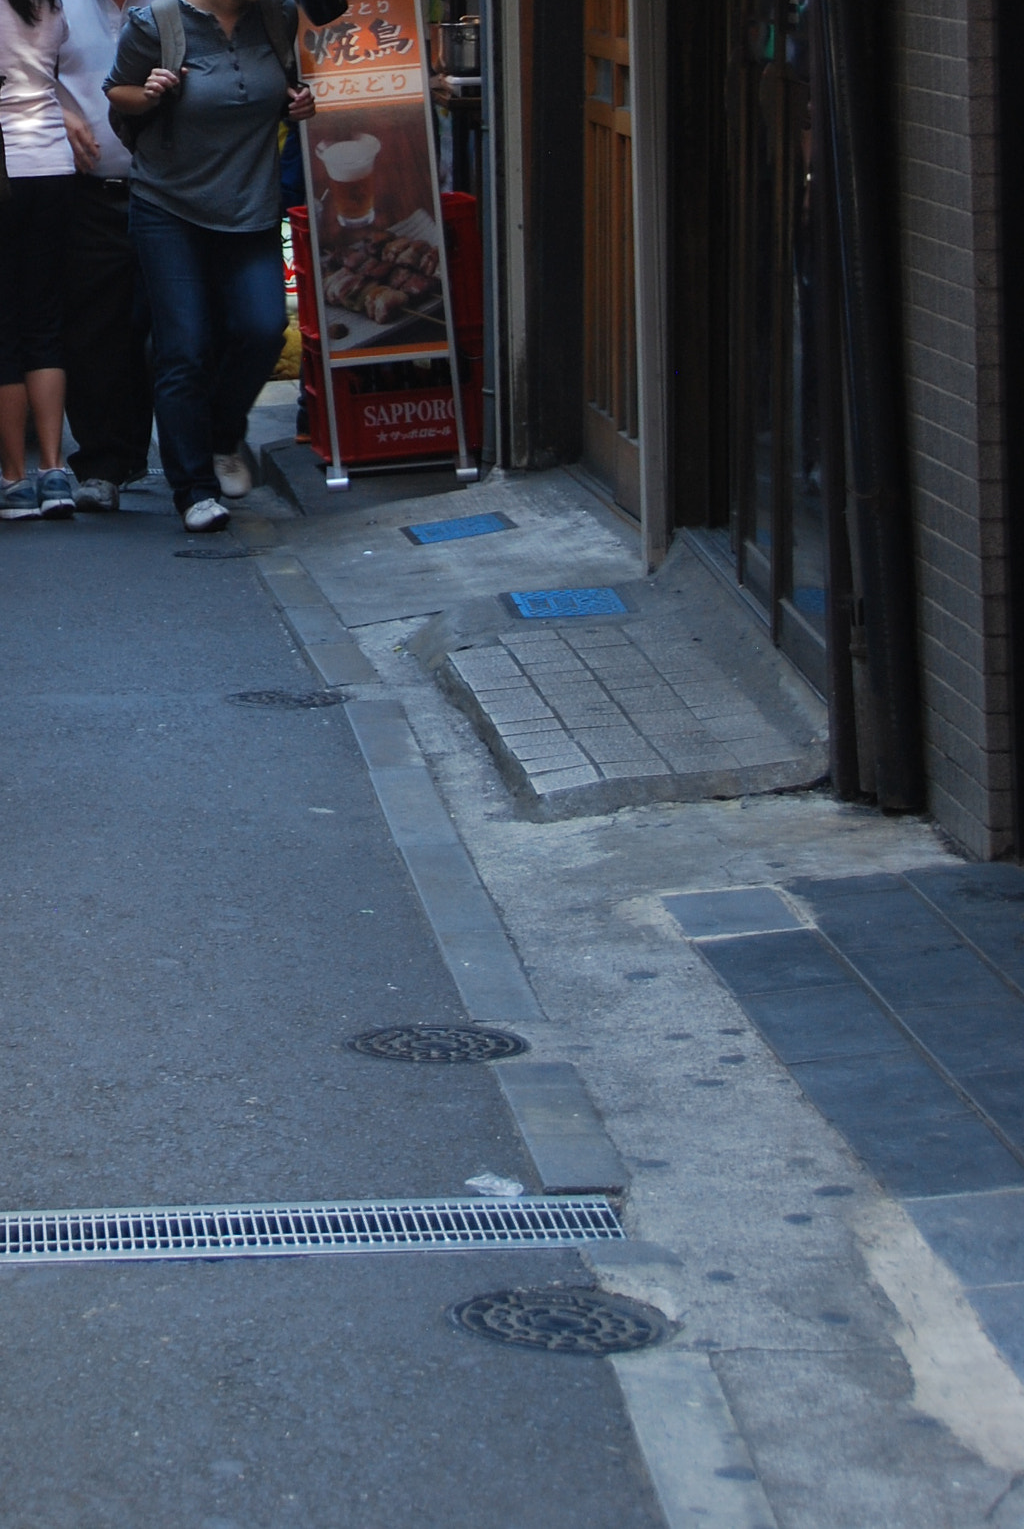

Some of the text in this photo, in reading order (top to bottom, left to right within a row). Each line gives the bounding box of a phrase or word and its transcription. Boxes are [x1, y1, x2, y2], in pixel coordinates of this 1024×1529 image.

[304, 18, 414, 67] 焼鳥
[312, 73, 407, 98] ひなどり
